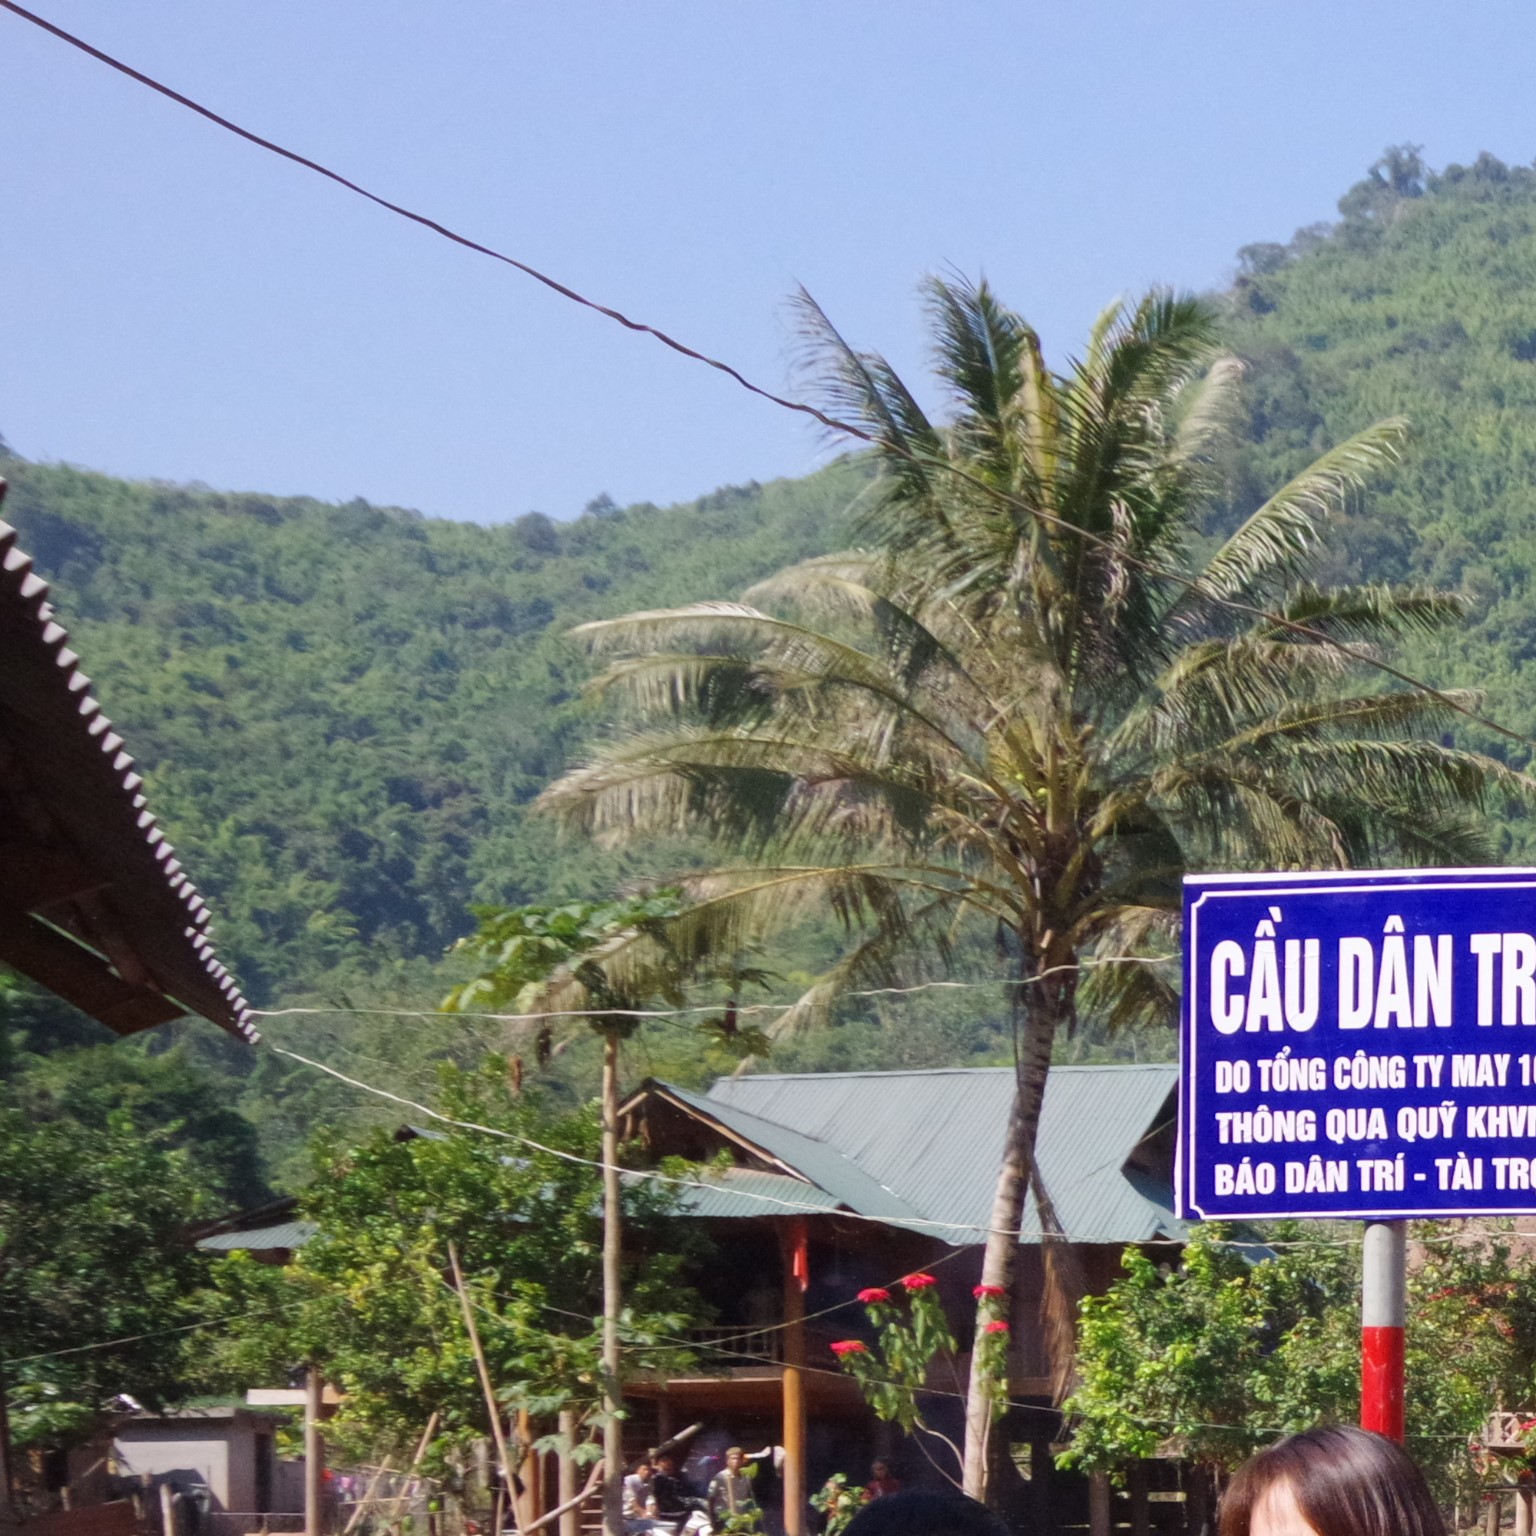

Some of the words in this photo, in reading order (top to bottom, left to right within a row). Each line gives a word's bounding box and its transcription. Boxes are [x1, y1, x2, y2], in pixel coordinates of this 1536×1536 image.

[1211, 906, 1319, 1034] CẦU
[1338, 915, 1452, 1030] DÂN
[1216, 1060, 1250, 1093] DO
[1258, 1046, 1326, 1092] TỔNG
[1334, 1050, 1406, 1089] CÔNG
[1413, 1055, 1444, 1087] TY
[1452, 1054, 1510, 1087] MAY
[1216, 1105, 1316, 1143] THÔNG
[1326, 1108, 1388, 1144] QUA
[1397, 1101, 1457, 1140] QUỸ
[1215, 1157, 1276, 1195] BÁO
[1285, 1155, 1347, 1194] DÂN
[1357, 1153, 1404, 1191] TRÍ
[1435, 1152, 1482, 1190] TÀI
